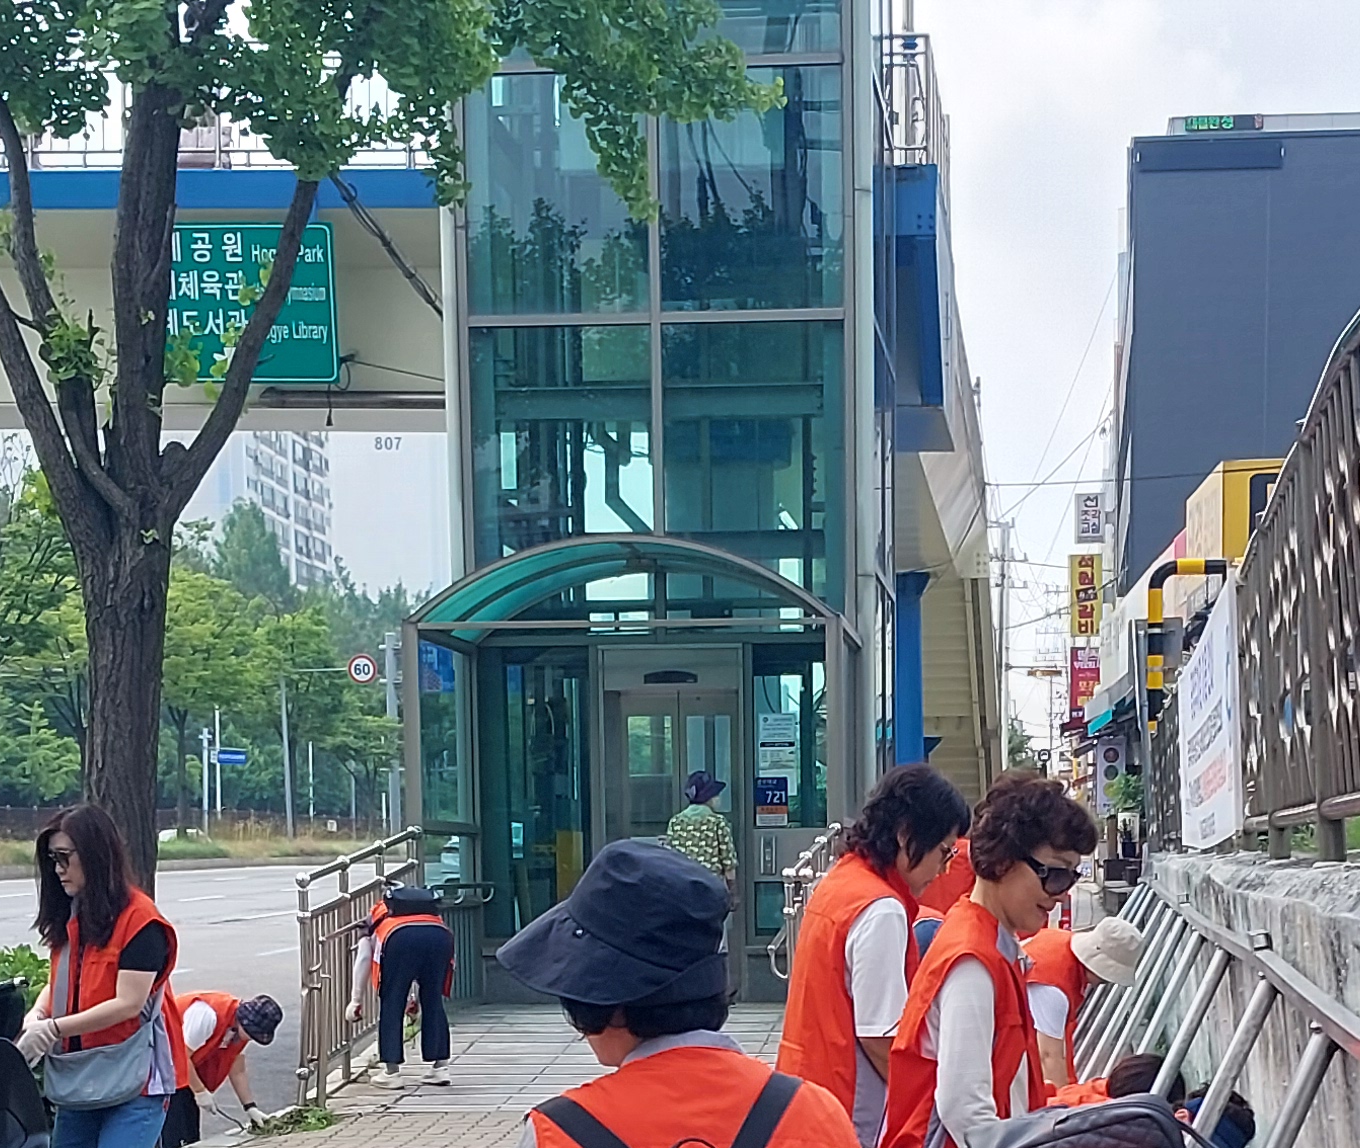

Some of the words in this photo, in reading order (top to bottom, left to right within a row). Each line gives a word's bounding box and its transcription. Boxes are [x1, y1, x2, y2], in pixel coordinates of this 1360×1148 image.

[292, 321, 327, 343] Library
[374, 436, 403, 451] 807
[353, 663, 371, 676] 60
[765, 791, 786, 804] 721
